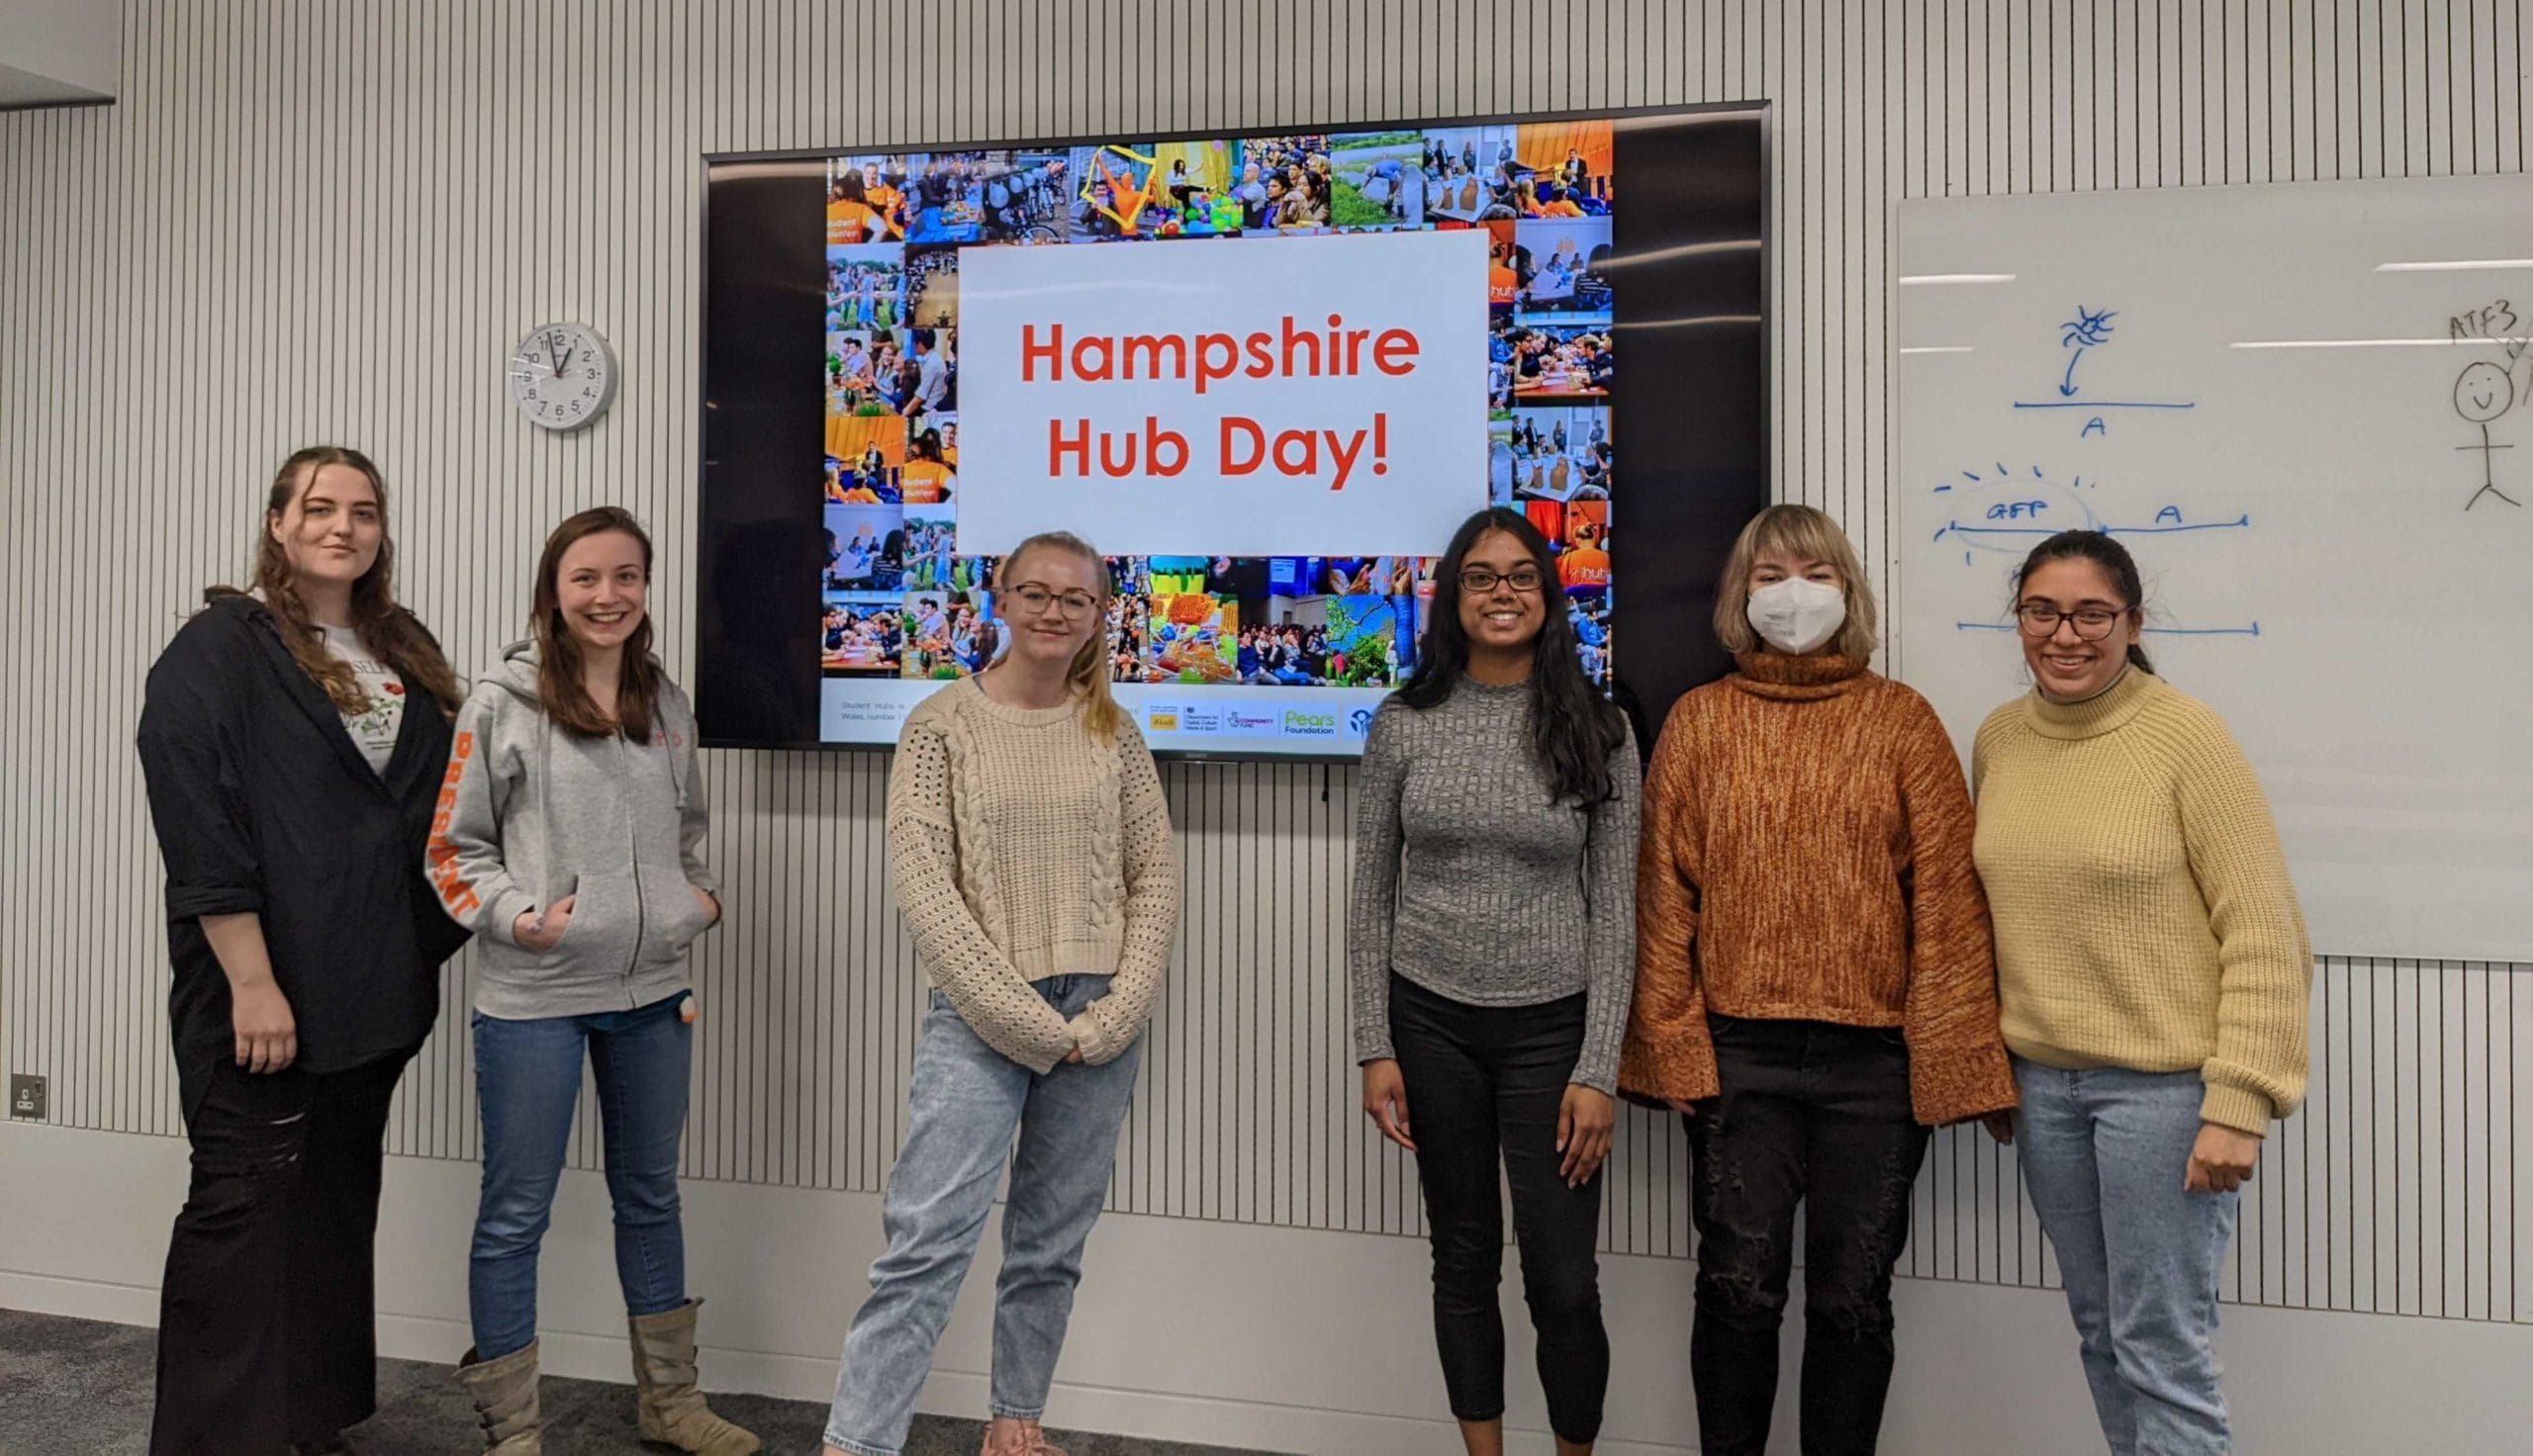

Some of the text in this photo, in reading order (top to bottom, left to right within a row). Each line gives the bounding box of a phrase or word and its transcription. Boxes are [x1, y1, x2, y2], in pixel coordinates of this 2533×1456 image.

[2449, 299, 2517, 345] ATF3
[539, 339, 548, 351] 11
[554, 334, 565, 346] 12
[523, 352, 540, 364] 10
[582, 350, 592, 362] 2
[1022, 314, 1420, 394] Hampshire
[523, 371, 532, 382] 9
[587, 368, 596, 380] 3
[527, 389, 536, 400] 8
[582, 386, 591, 397] 4
[539, 401, 548, 412] 7
[555, 405, 564, 416] 6
[571, 400, 580, 411] 5
[2081, 416, 2107, 438] A
[1050, 412, 1387, 491] Hub Day!
[1986, 500, 2048, 519] GFP
[2155, 505, 2183, 523] A
[1284, 710, 1335, 727] Pears
[1284, 726, 1335, 735] Foundation
